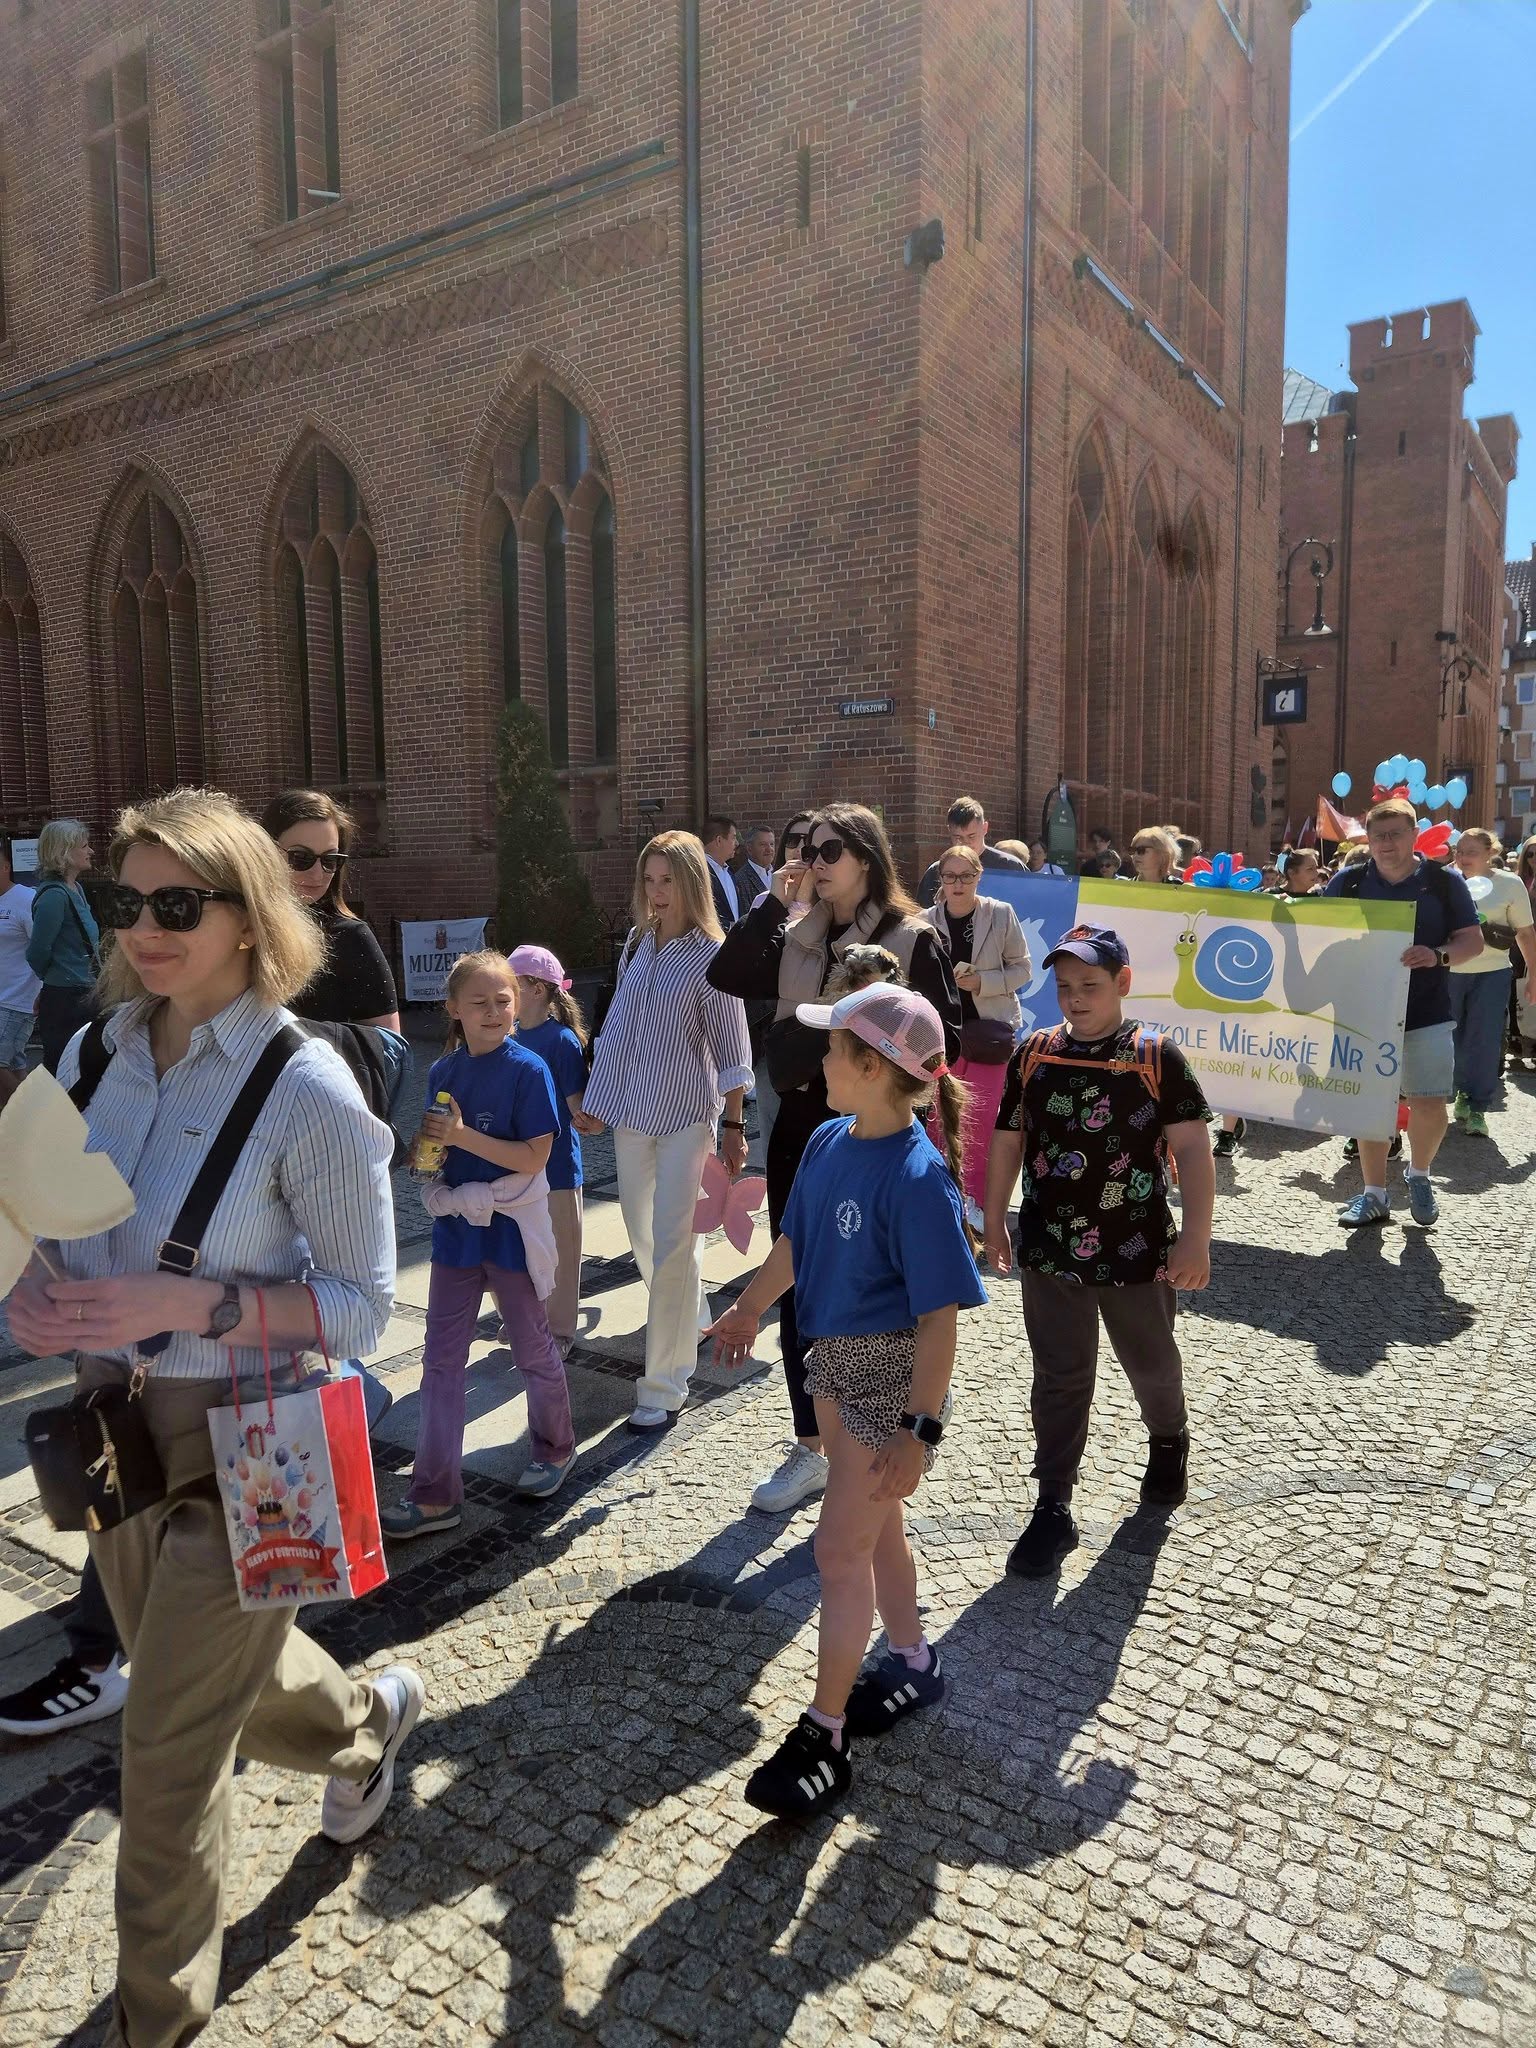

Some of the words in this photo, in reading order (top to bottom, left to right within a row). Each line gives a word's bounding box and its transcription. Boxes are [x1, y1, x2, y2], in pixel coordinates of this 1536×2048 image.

[852, 704, 887, 714] Ratuszowa
[1375, 1041, 1399, 1077] 3
[1046, 1102, 1073, 1117] GAME
[1099, 1181, 1114, 1210] GAME
[246, 1547, 275, 1568] HAPPY
[274, 1545, 321, 1561] BIRTHDAY
